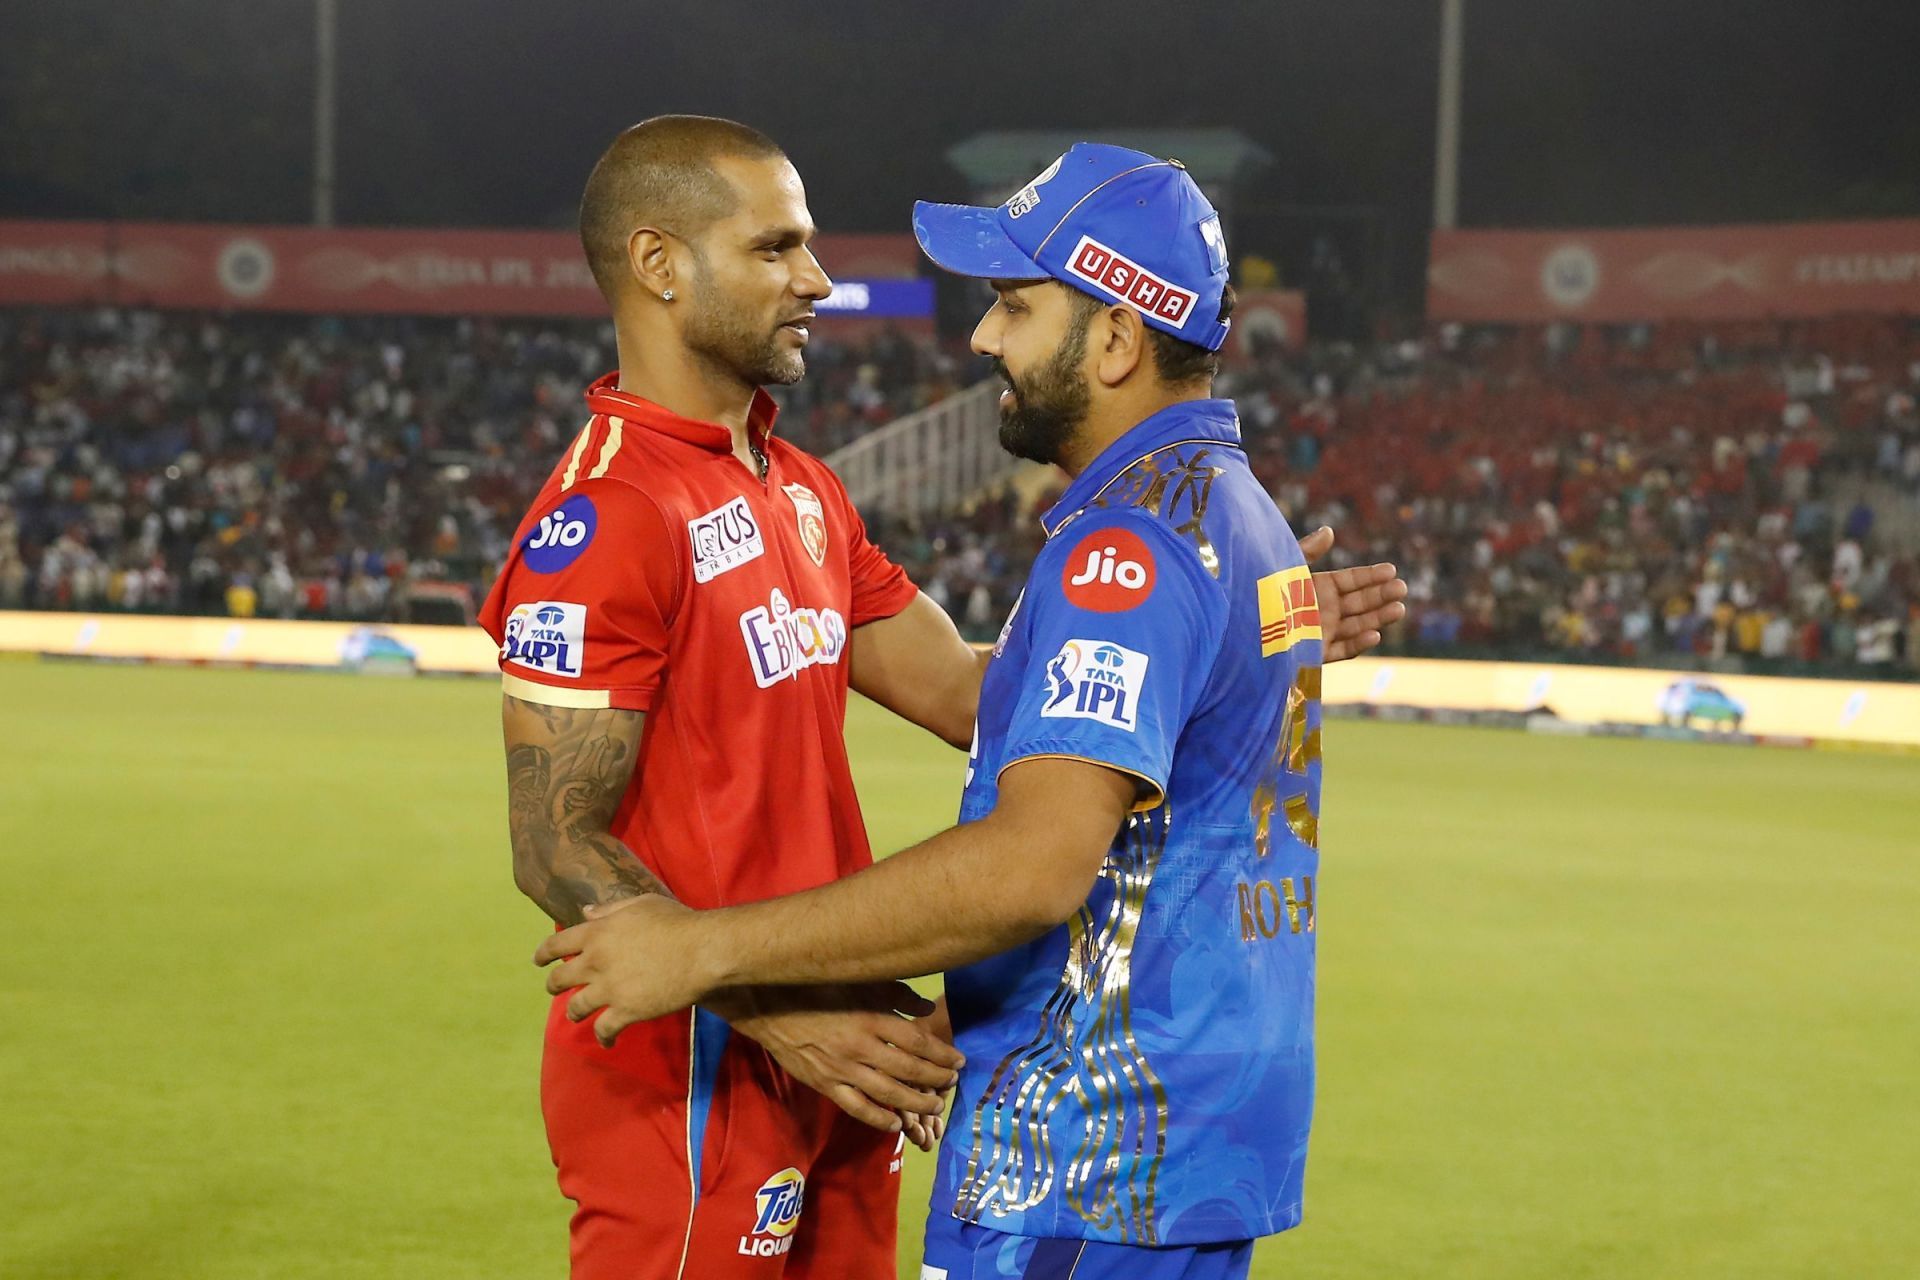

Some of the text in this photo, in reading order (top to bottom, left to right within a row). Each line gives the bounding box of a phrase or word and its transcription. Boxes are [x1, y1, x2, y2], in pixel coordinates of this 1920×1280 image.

[1079, 247, 1186, 318] USHA
[529, 510, 587, 549] Jio
[691, 503, 755, 564] LOTUS
[1071, 546, 1147, 590] Jio
[531, 629, 566, 642] TATA
[520, 640, 577, 674] IPL
[1085, 667, 1125, 688] TATA
[1075, 680, 1131, 725] IPL
